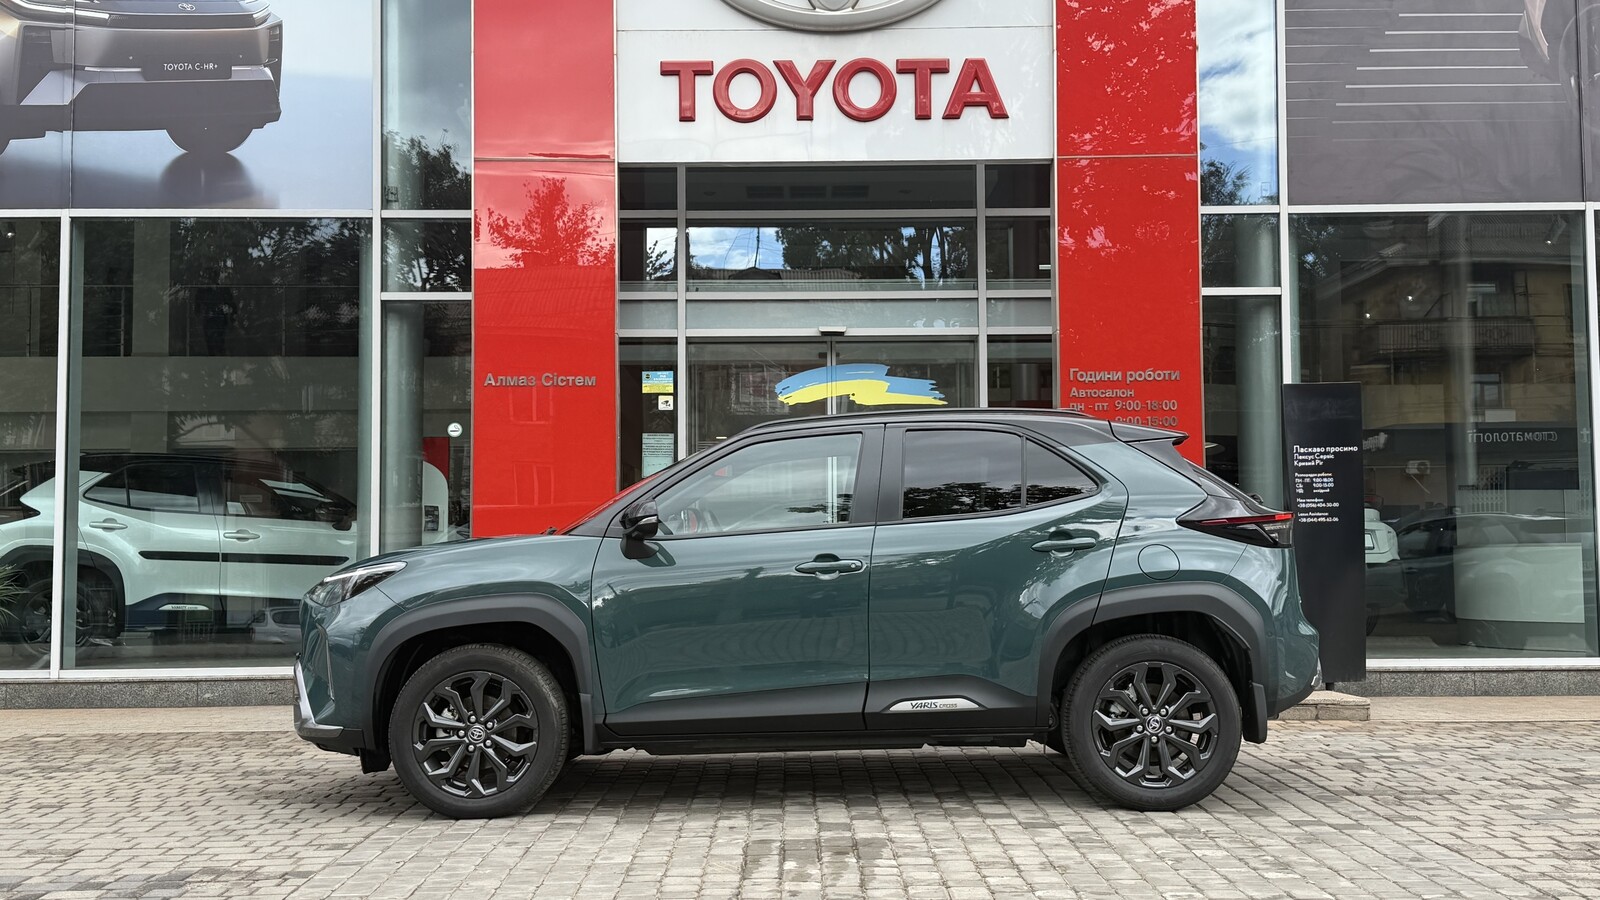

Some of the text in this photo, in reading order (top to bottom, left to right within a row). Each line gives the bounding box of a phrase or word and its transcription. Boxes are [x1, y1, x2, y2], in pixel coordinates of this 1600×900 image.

[163, 63, 193, 71] TOYOTA
[660, 57, 1010, 123] TOYOTA
[483, 372, 597, 386] Алмаз Сістем
[1069, 367, 1181, 385] Години роботи
[1069, 387, 1135, 398] Автосалон
[1094, 402, 1109, 411] пт
[1114, 399, 1178, 411] 9:00-18:00
[1293, 445, 1325, 453] Ласкаво
[910, 701, 938, 709] YARIS
